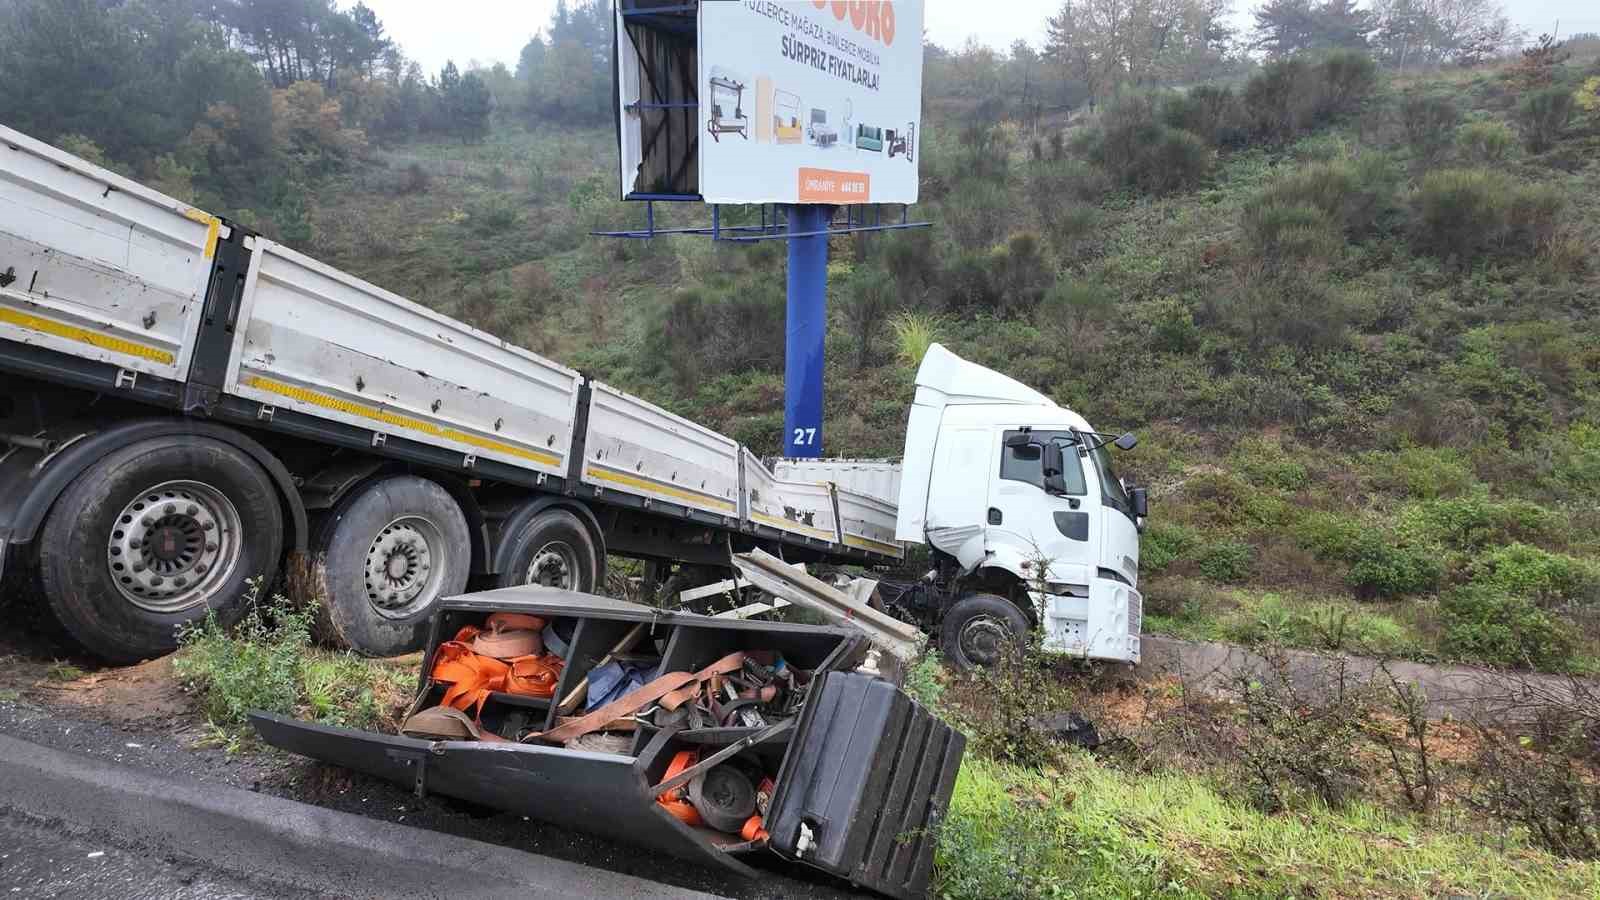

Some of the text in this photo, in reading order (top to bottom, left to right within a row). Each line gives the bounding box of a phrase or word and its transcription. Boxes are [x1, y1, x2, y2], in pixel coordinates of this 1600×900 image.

[782, 34, 880, 91] SÜRPRİZ FİYATLARLA!
[793, 428, 816, 445] 27
